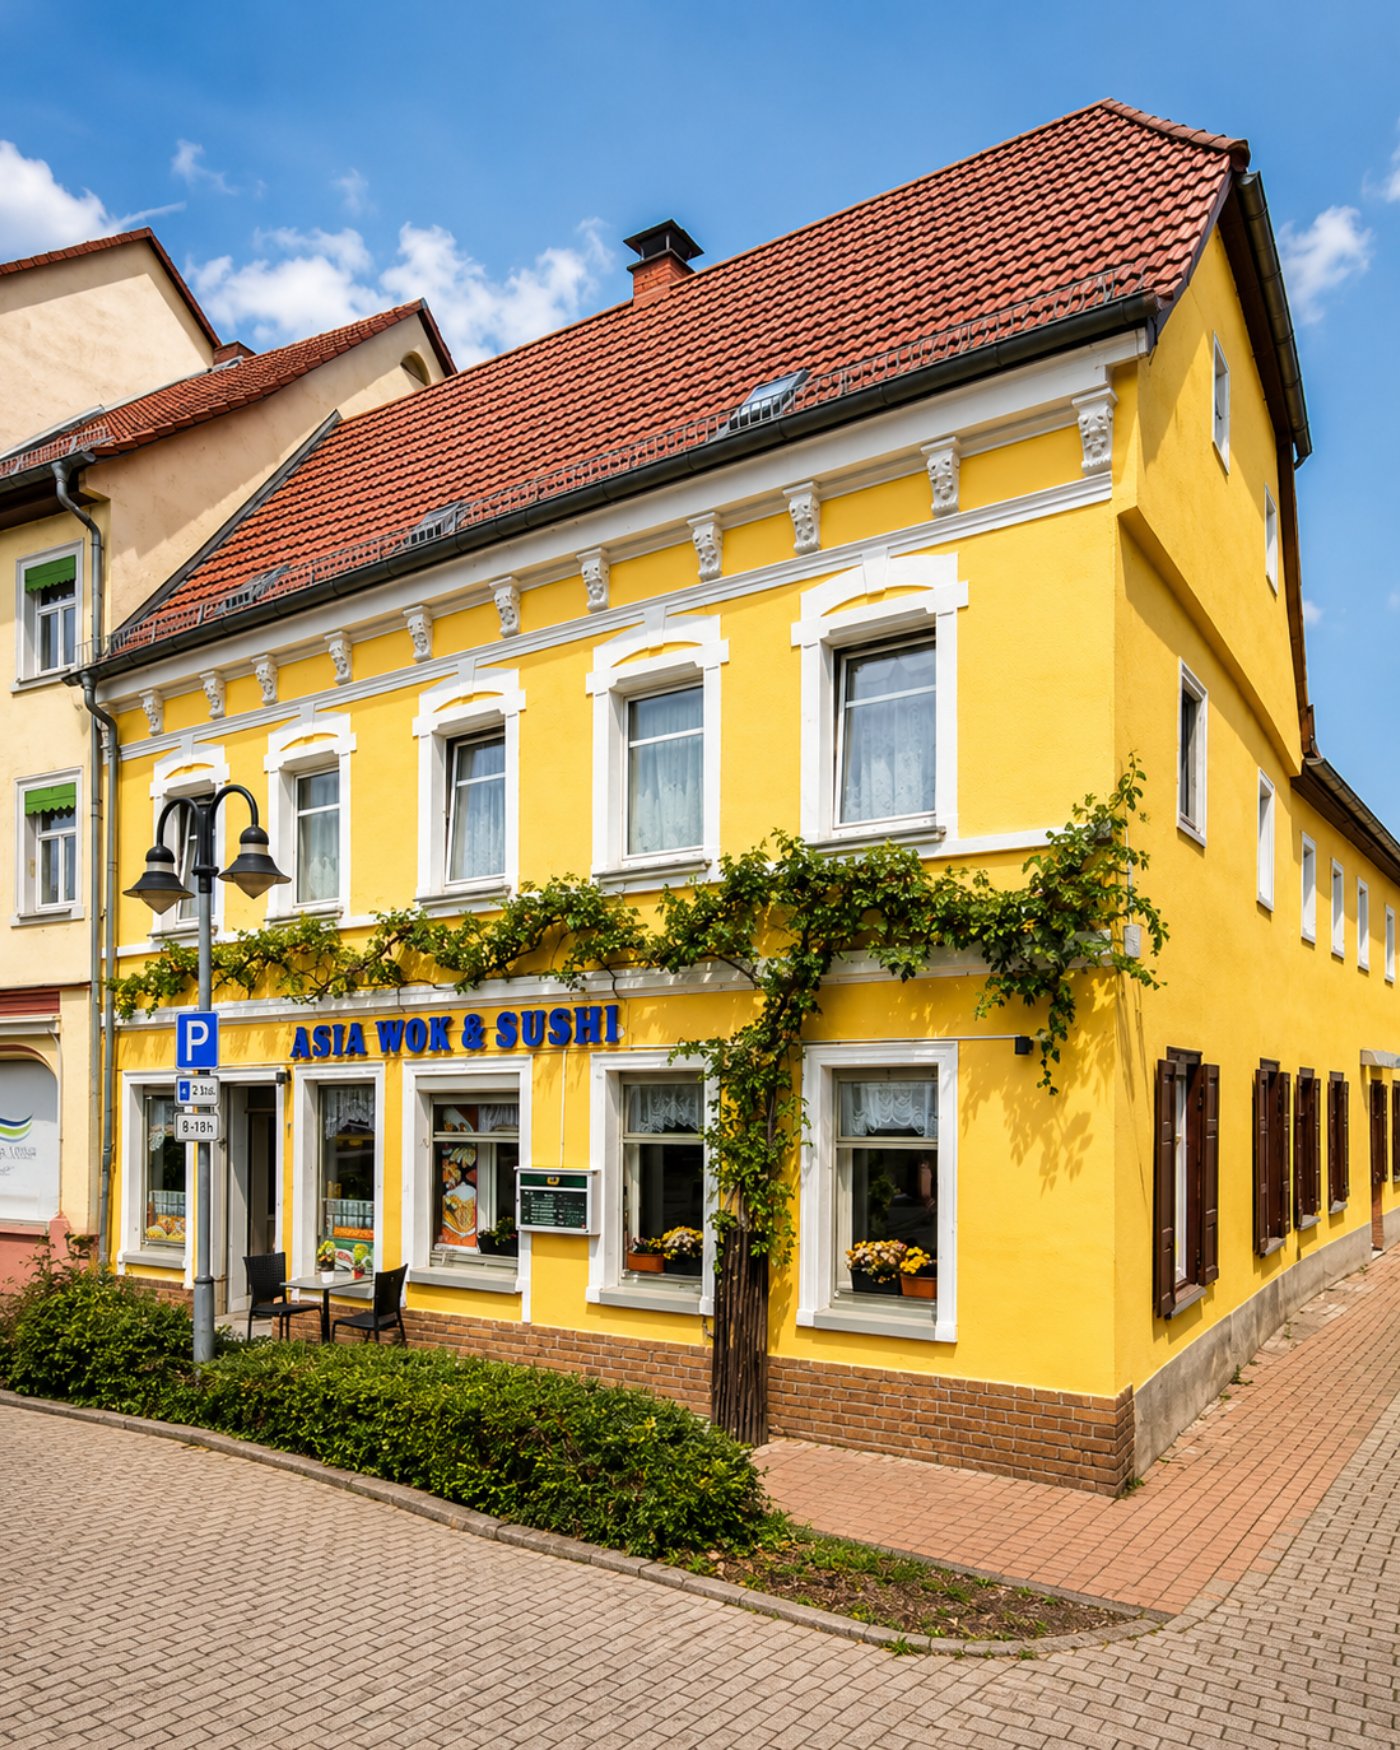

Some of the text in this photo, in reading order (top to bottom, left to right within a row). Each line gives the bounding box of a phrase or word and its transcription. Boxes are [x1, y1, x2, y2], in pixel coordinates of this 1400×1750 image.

[186, 1020, 210, 1061] P
[290, 1005, 619, 1058] ASIA WOK & SUSHI
[192, 1084, 199, 1096] 2
